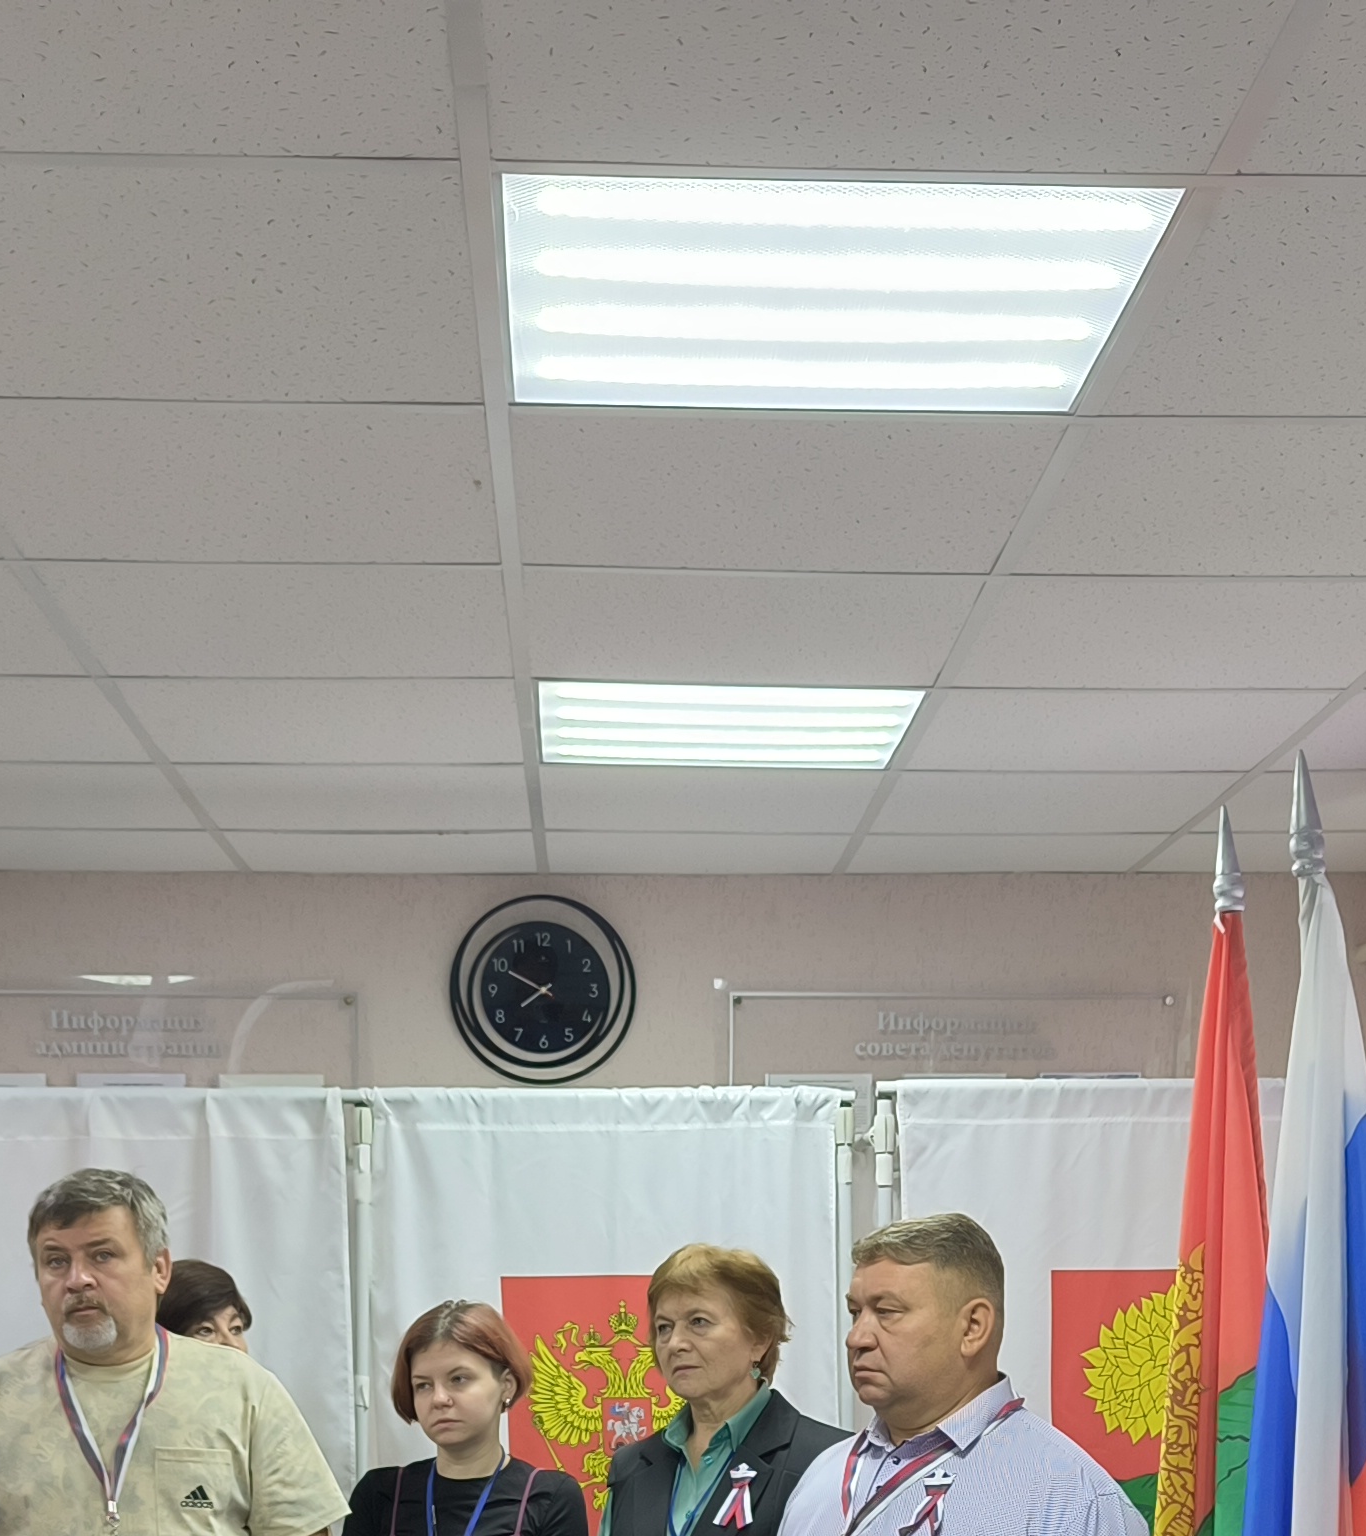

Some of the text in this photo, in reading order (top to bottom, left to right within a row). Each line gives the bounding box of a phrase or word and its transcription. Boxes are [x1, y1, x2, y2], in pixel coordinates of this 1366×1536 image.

[513, 939, 525, 953] 11
[535, 933, 551, 947] 12
[566, 939, 572, 953] 1
[492, 958, 508, 973] 10
[582, 959, 592, 973] 2
[488, 984, 498, 998] 9
[588, 983, 599, 998] 3
[495, 1009, 505, 1024] 8
[581, 1009, 592, 1023] 4
[513, 1028, 524, 1042] 7
[539, 1035, 549, 1049] 6
[564, 1028, 574, 1042] 5
[854, 1041, 930, 1056] совета
